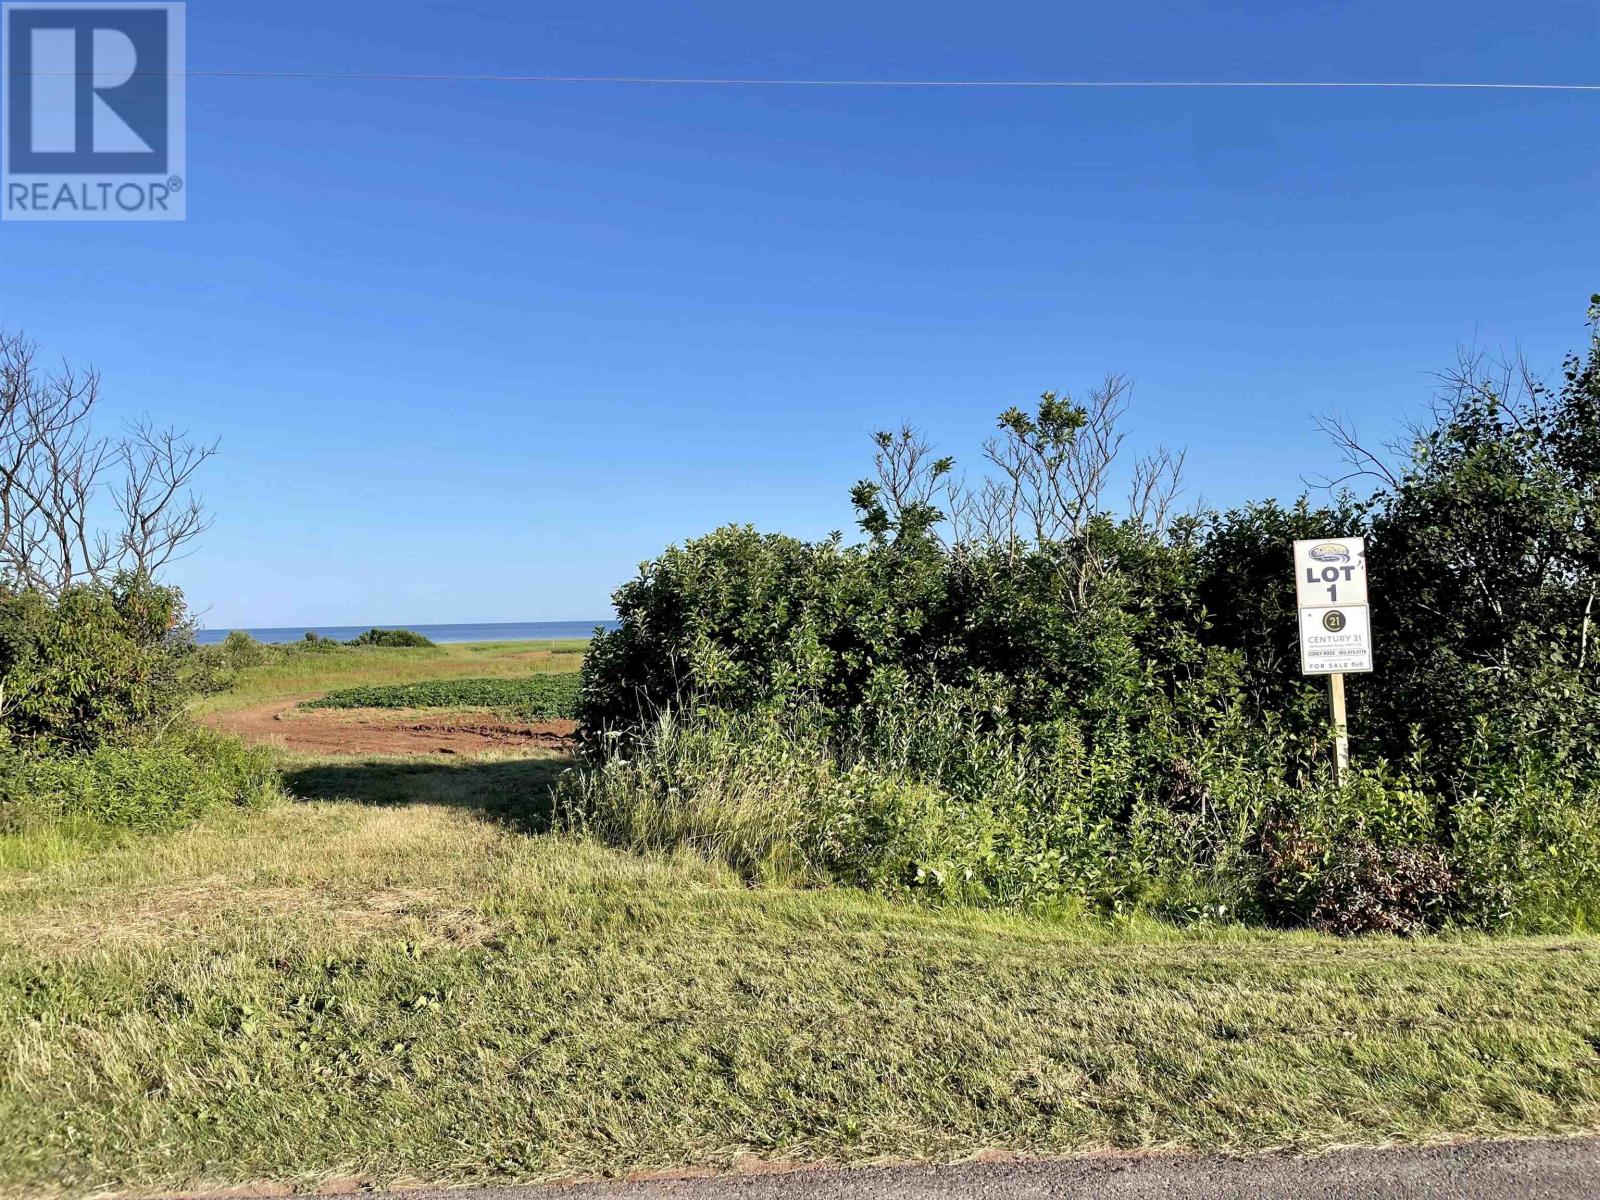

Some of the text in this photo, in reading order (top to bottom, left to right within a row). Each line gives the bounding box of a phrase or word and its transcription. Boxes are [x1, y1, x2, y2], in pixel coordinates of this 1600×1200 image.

[1306, 565, 1355, 583] LOT
[1326, 584, 1337, 602] 1
[1307, 634, 1362, 644] CENTURY 21
